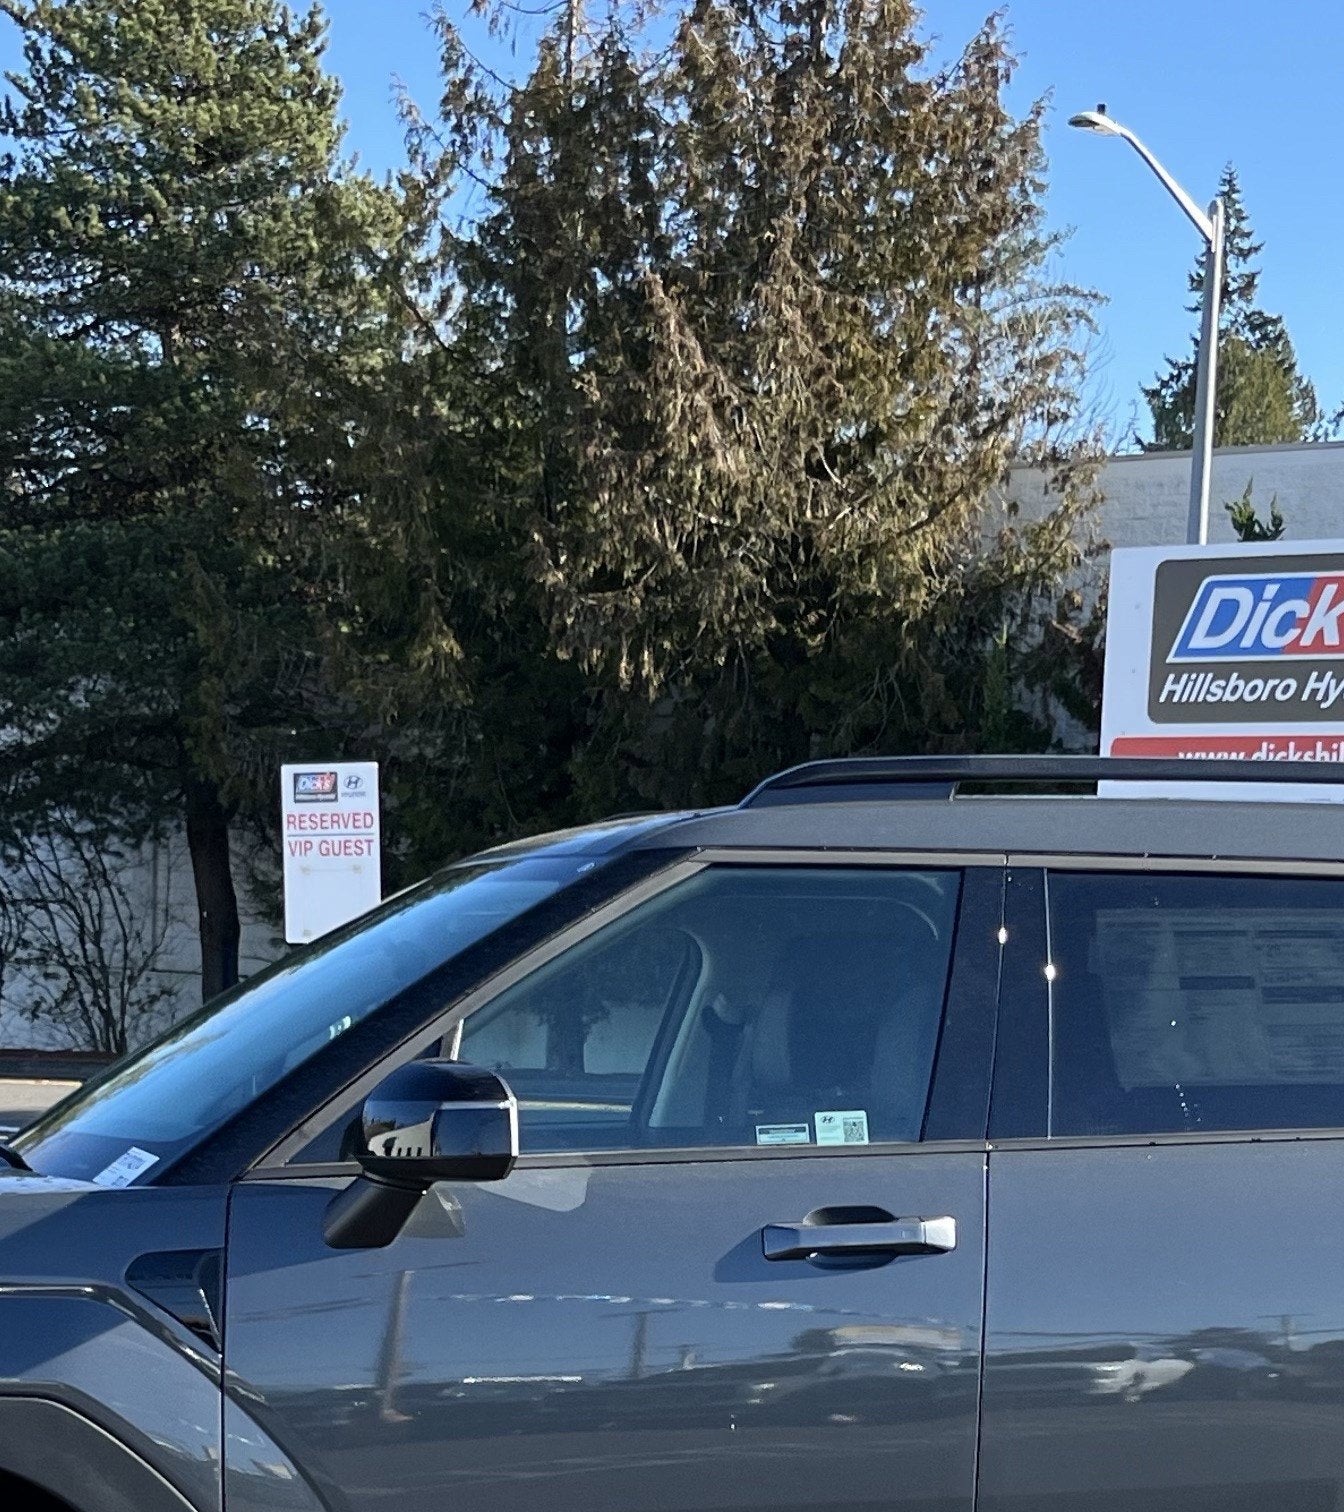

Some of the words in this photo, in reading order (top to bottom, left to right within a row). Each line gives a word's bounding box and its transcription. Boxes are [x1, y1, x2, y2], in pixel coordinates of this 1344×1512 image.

[1158, 672, 1297, 703] Hillsboro
[286, 812, 374, 830] RESERVED
[288, 840, 313, 857] VIP
[319, 839, 374, 856] GUEST
